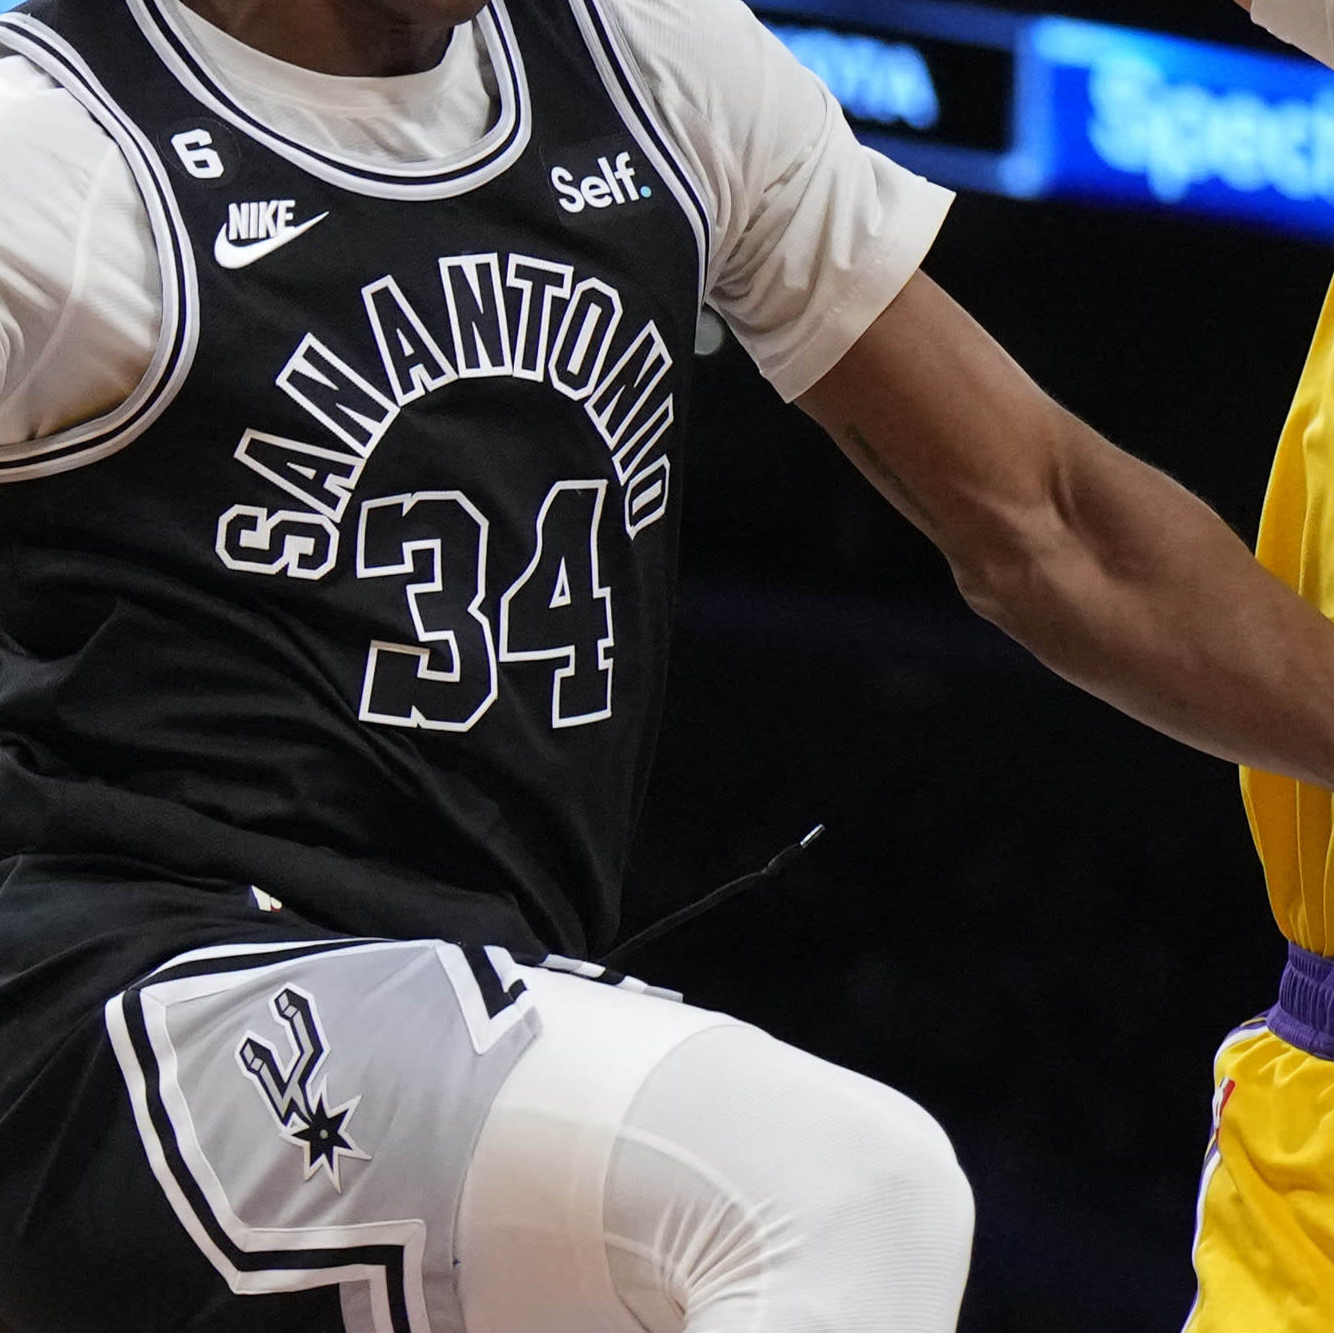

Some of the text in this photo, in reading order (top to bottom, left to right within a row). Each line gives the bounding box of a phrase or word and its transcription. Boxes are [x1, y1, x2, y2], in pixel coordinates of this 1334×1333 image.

[171, 128, 225, 180] 6
[227, 199, 296, 240] NIKE
[216, 252, 674, 580] SAN ANTONIO
[356, 479, 615, 732] 34
